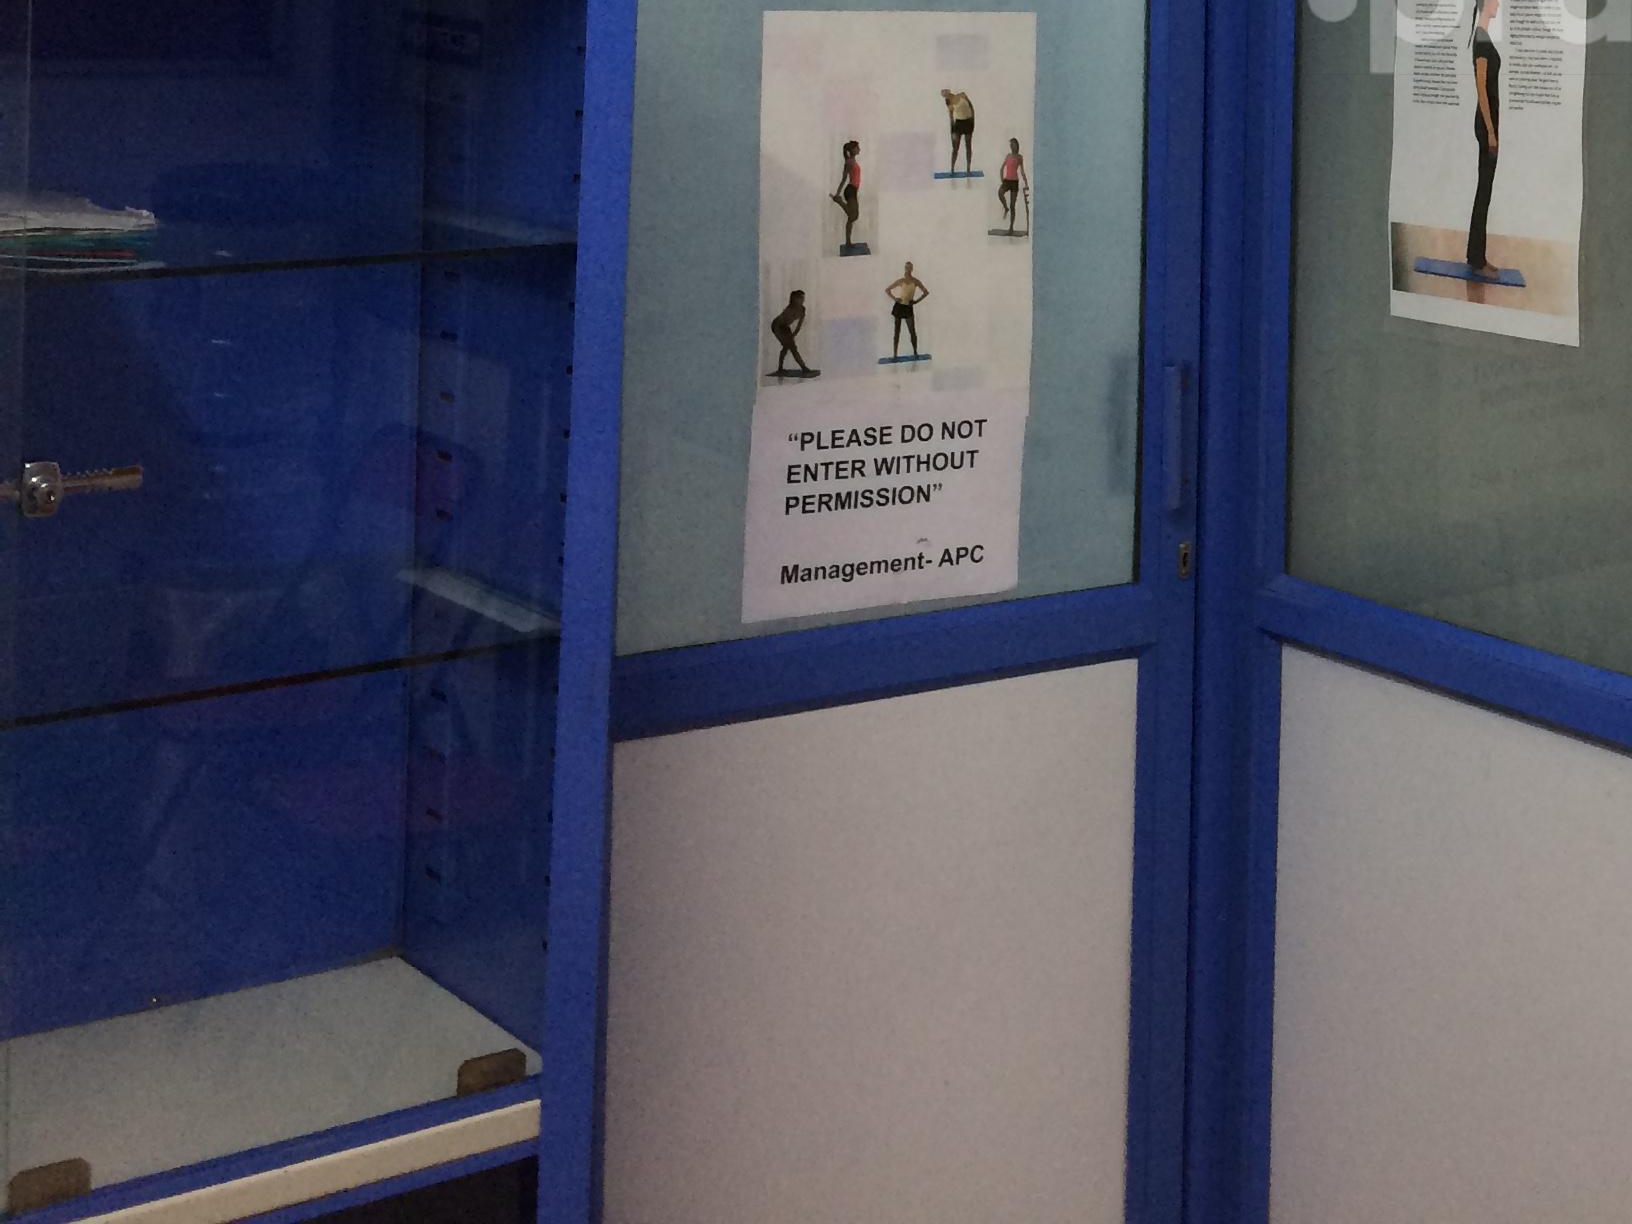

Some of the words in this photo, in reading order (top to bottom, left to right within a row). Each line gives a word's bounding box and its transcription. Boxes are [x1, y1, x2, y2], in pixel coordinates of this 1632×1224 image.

[788, 425, 893, 452] “PLEASE
[900, 422, 934, 444] DO
[941, 418, 988, 440] NOT
[786, 459, 867, 484] ENTER
[873, 449, 980, 477] WITHOUT
[784, 482, 944, 516] PERMISSION”
[779, 551, 933, 585] Management-
[937, 544, 985, 568] APC
